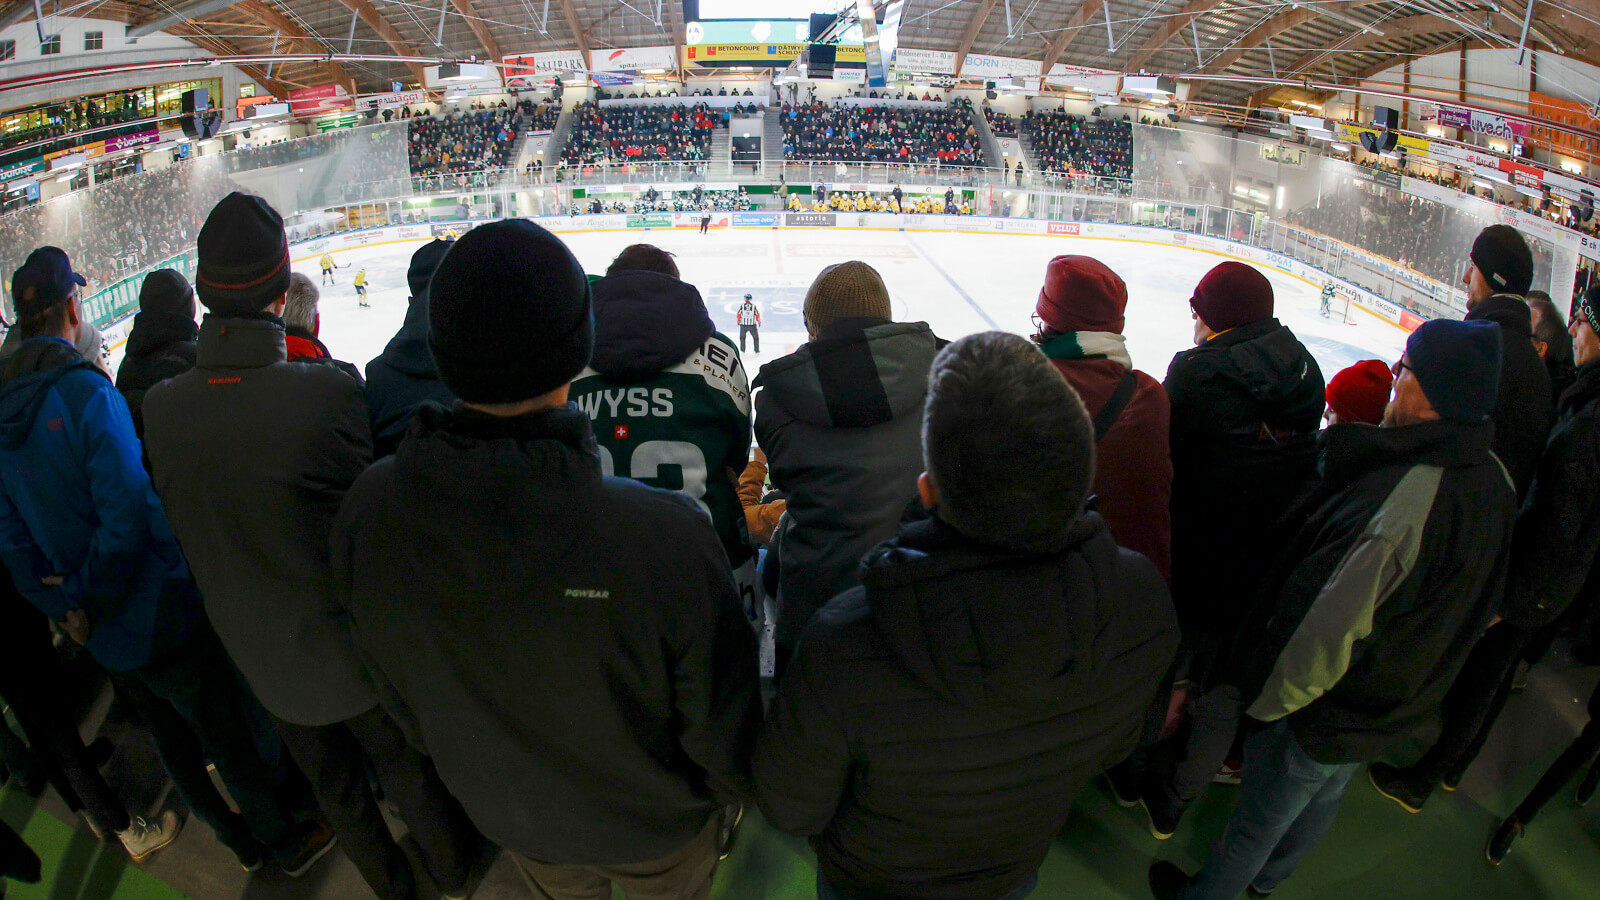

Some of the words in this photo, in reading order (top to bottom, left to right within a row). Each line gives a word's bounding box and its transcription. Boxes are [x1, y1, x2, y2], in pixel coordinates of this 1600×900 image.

[965, 56, 999, 68] BORN
[1001, 59, 1039, 73] REISEN
[1050, 223, 1080, 234] VELUX
[1266, 252, 1292, 269] SOGAS
[1585, 305, 1600, 332] Olten
[703, 365, 747, 401] PLANER
[577, 387, 674, 421] WYSS
[564, 588, 610, 599] PGWEAR
